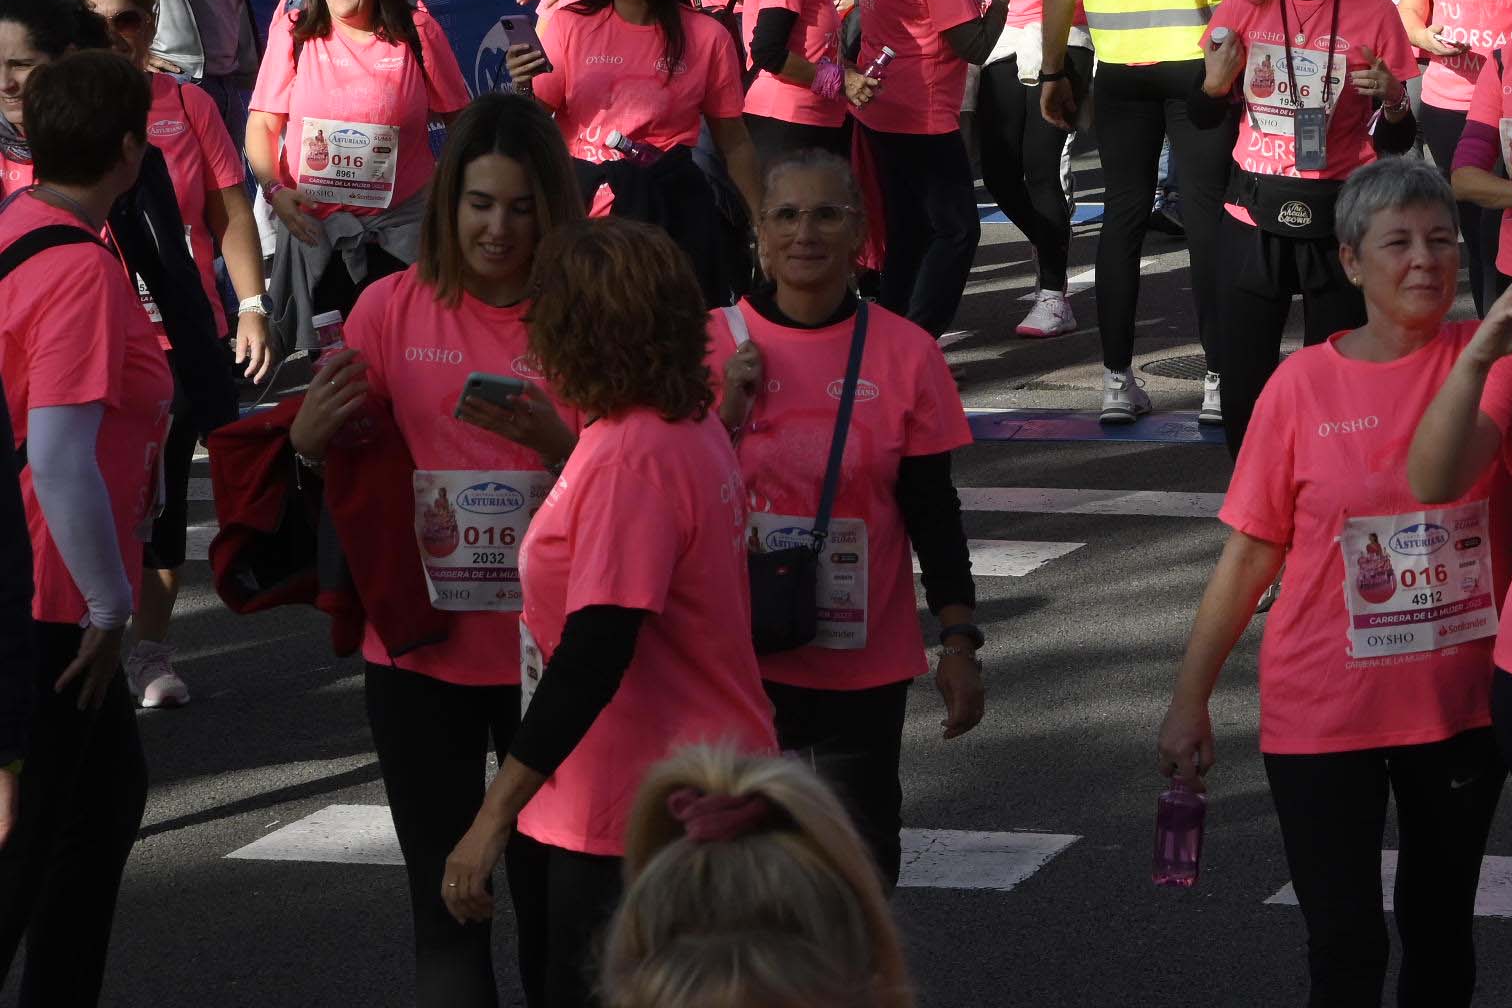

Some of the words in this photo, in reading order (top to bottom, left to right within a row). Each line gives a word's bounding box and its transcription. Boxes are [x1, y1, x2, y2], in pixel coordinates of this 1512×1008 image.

[1440, 2, 1461, 18] TU
[1248, 30, 1285, 42] OYSHO
[585, 55, 624, 65] OYSHO
[1440, 54, 1482, 70] SUM
[1277, 81, 1311, 97] 06
[1252, 105, 1279, 115] CARRERA
[151, 124, 185, 135] ASTURIANA
[332, 135, 367, 145] ASTURIANA
[331, 153, 364, 168] 016
[335, 169, 356, 179] 8961
[309, 178, 335, 187] CARRERA
[352, 182, 371, 190] MUJER
[356, 193, 386, 201] Santander
[405, 346, 464, 365] OYSHO
[1317, 415, 1379, 438] OYSHO
[460, 494, 520, 508] ASTURIANA
[464, 525, 516, 547] 016
[1392, 532, 1446, 550] ASTURIANA
[472, 551, 506, 565] 2032
[470, 569, 484, 579] DE
[485, 569, 498, 578] LA
[1400, 563, 1448, 589] 016
[1411, 590, 1443, 606] 4912
[1369, 614, 1411, 625] CARRERA
[1413, 612, 1426, 621] DE
[1427, 610, 1438, 618] LA
[1439, 603, 1464, 616] MUJER
[1448, 616, 1488, 633] Santander
[1367, 631, 1414, 648] OYSHO
